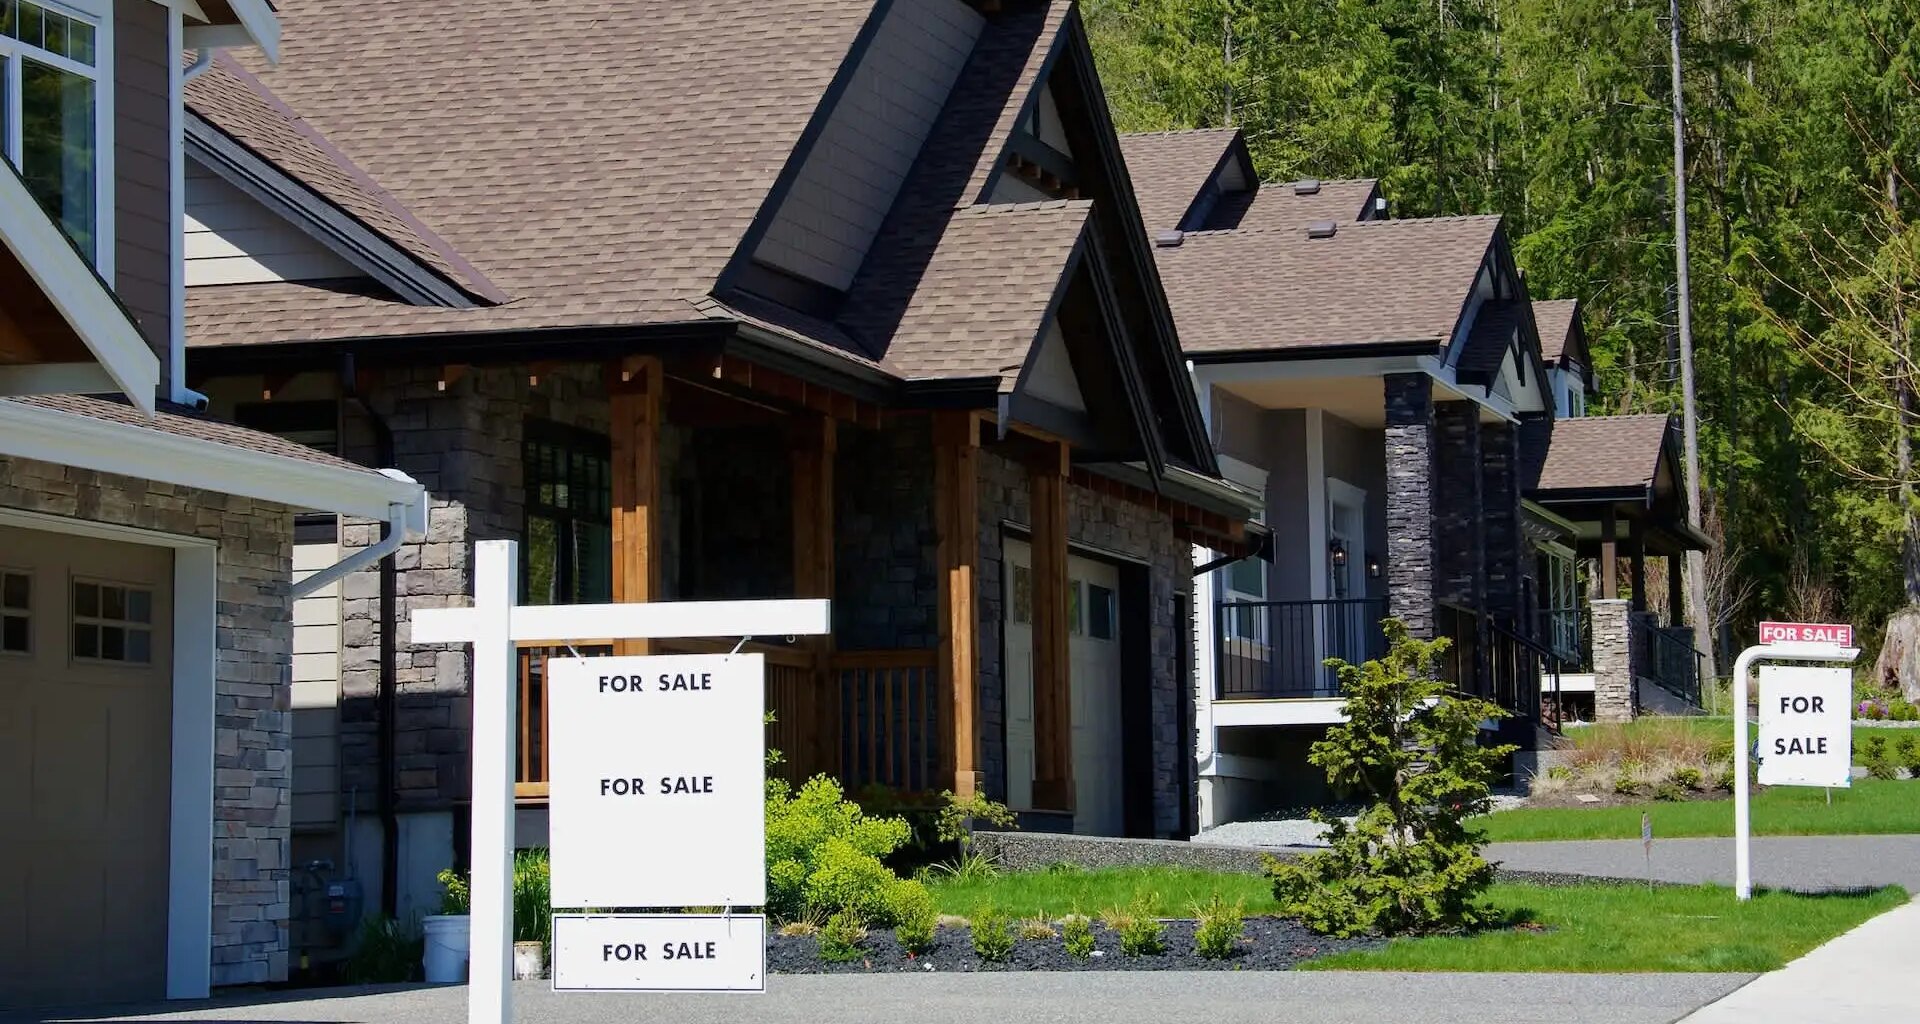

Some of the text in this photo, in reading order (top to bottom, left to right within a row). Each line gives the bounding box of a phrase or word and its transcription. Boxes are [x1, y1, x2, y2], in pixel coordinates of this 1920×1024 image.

[1763, 627, 1847, 642] FOR SALE
[599, 673, 712, 693] FOR SALE
[1780, 695, 1825, 714] FOR
[1775, 737, 1828, 756] SALE
[600, 776, 713, 796] FOR SALE
[603, 941, 716, 962] FOR SALE
